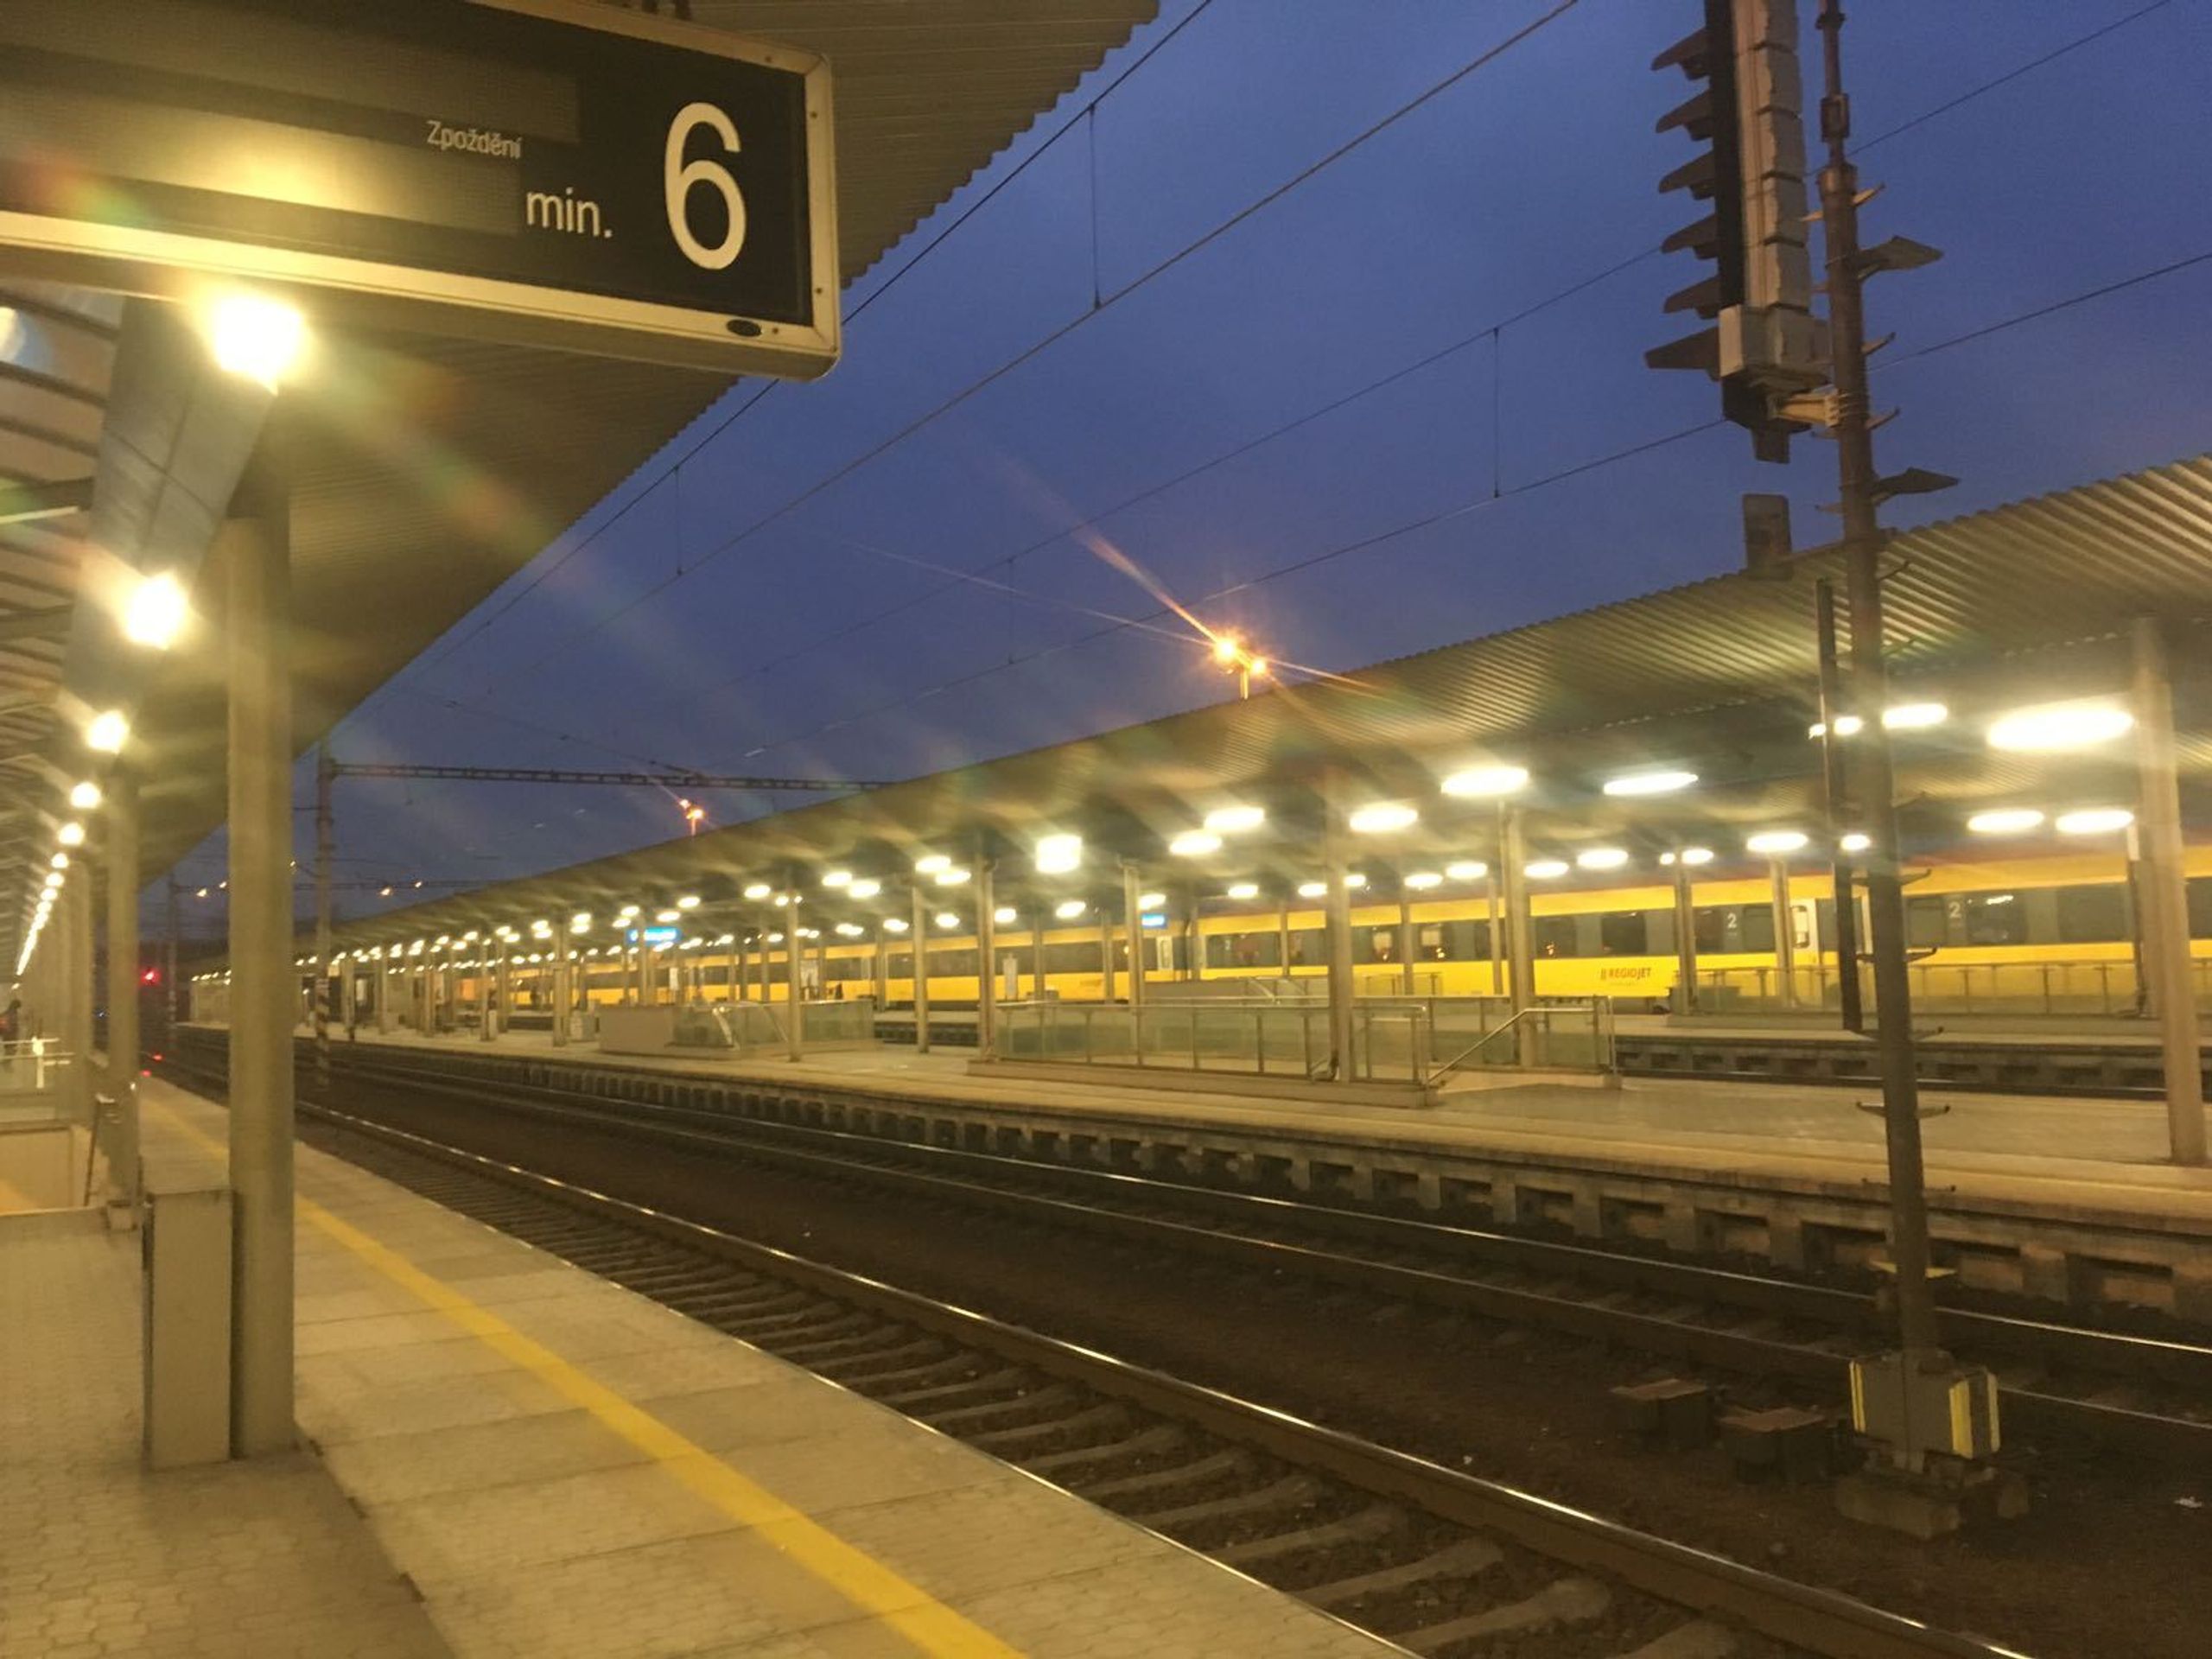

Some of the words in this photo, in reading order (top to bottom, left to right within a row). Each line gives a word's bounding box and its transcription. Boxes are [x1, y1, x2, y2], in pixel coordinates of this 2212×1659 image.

[427, 119, 524, 159] Zpoždění
[664, 101, 747, 270] 6
[526, 186, 613, 238] min.
[1727, 912, 1738, 929] 2
[1948, 901, 1962, 918] 2
